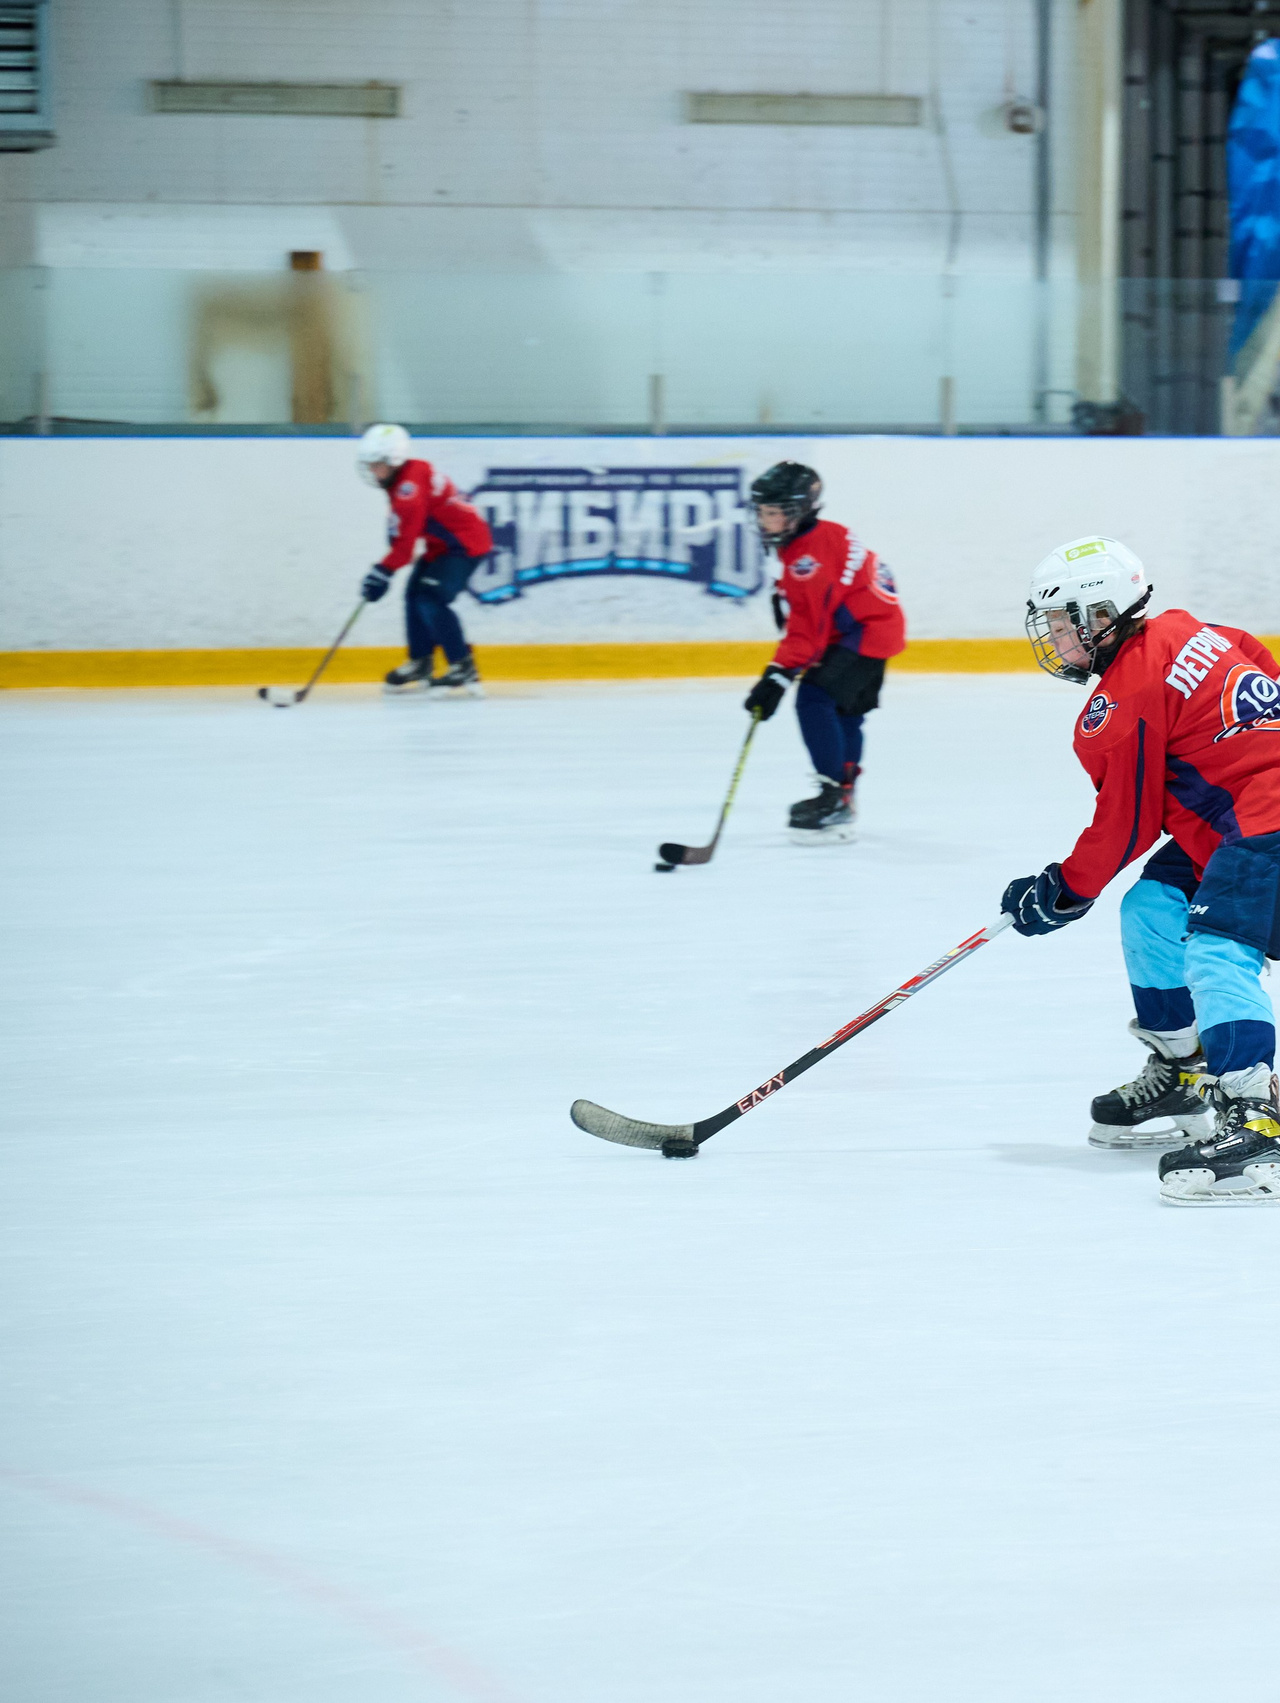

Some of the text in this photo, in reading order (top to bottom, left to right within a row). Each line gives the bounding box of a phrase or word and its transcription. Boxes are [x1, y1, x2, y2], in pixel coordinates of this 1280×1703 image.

[468, 489, 764, 594] СИБИРЬ
[1080, 580, 1104, 588] CCM
[1165, 627, 1233, 699] ПЕТРОВ
[1090, 698, 1104, 713] 10
[1238, 676, 1279, 712] 10
[1189, 905, 1209, 914] CM
[737, 1071, 784, 1114] EAZY
